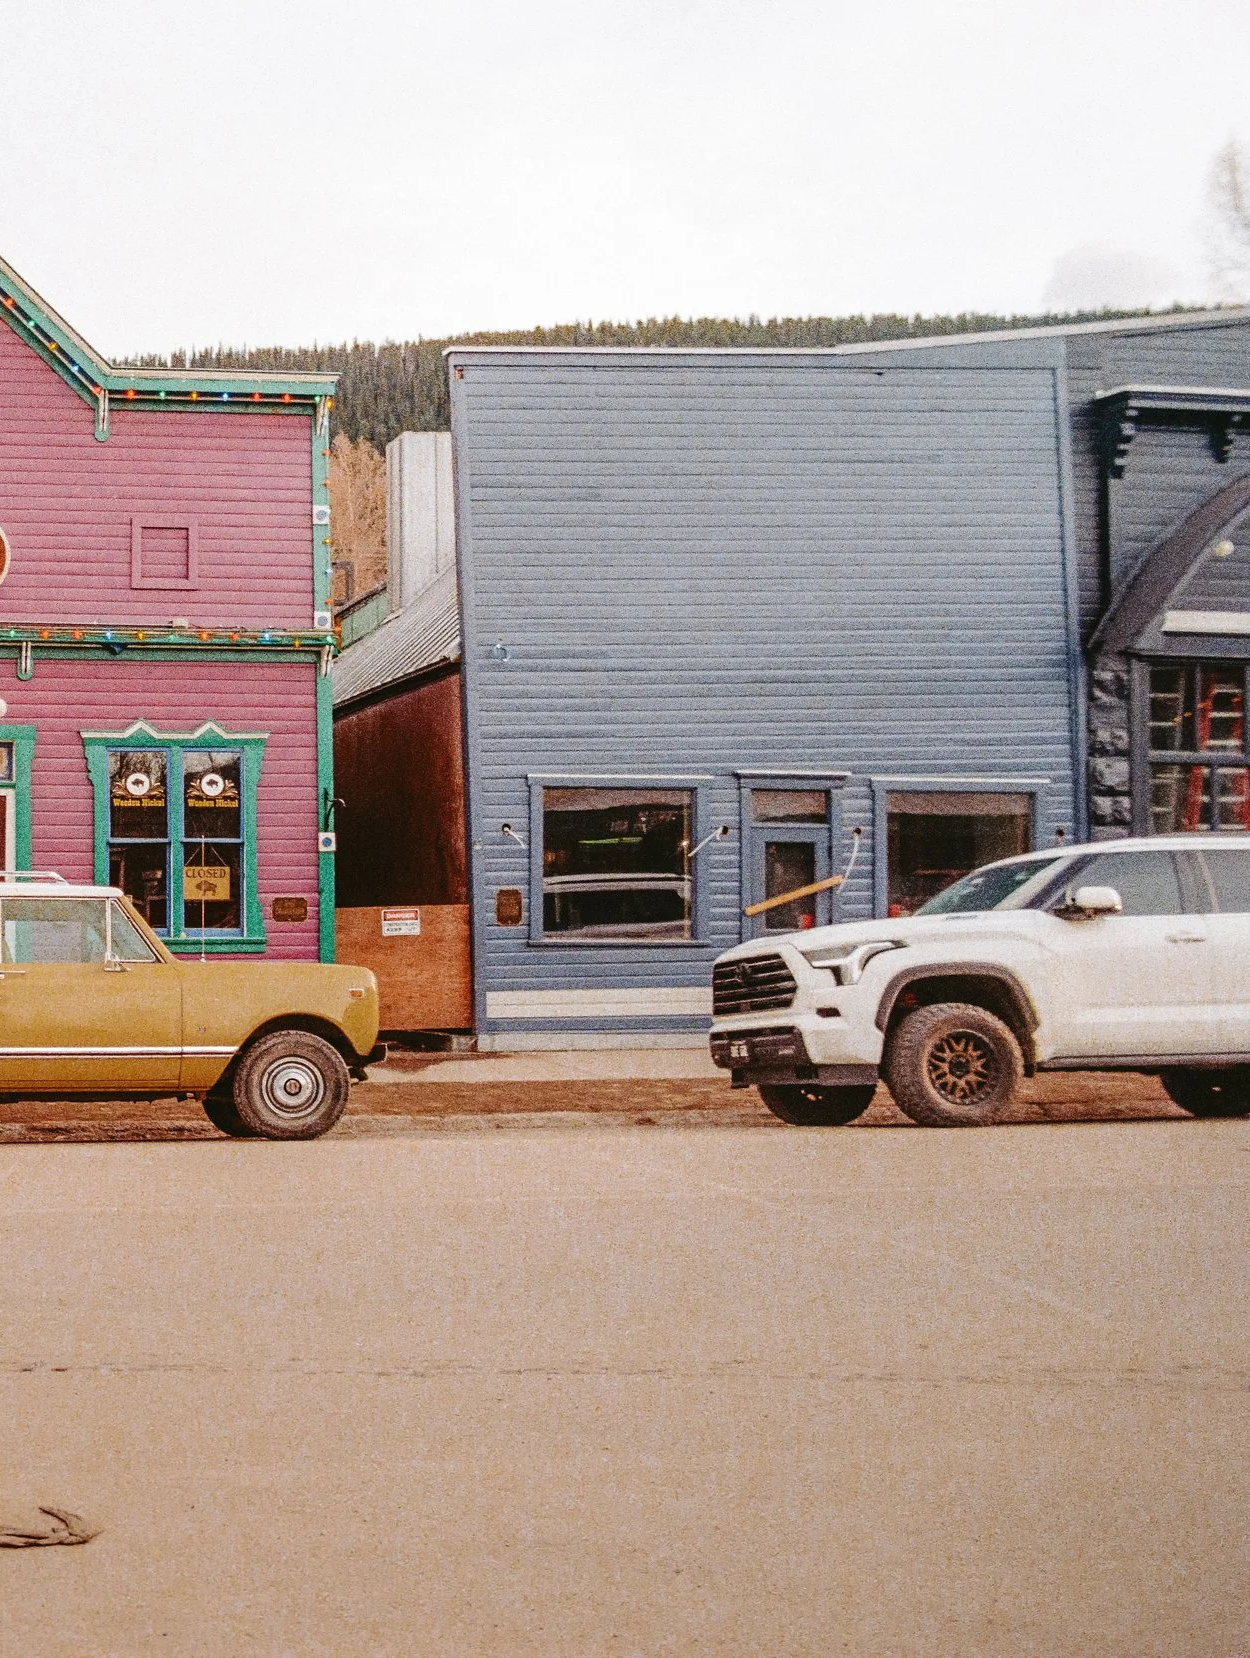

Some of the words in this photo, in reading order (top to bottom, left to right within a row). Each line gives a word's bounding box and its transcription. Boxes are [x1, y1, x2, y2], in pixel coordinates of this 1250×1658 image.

[113, 799, 141, 807] Wooden
[142, 799, 165, 807] Nickel
[188, 799, 214, 807] Wooden
[215, 799, 239, 808] Nickel
[185, 868, 226, 879] CLOSED
